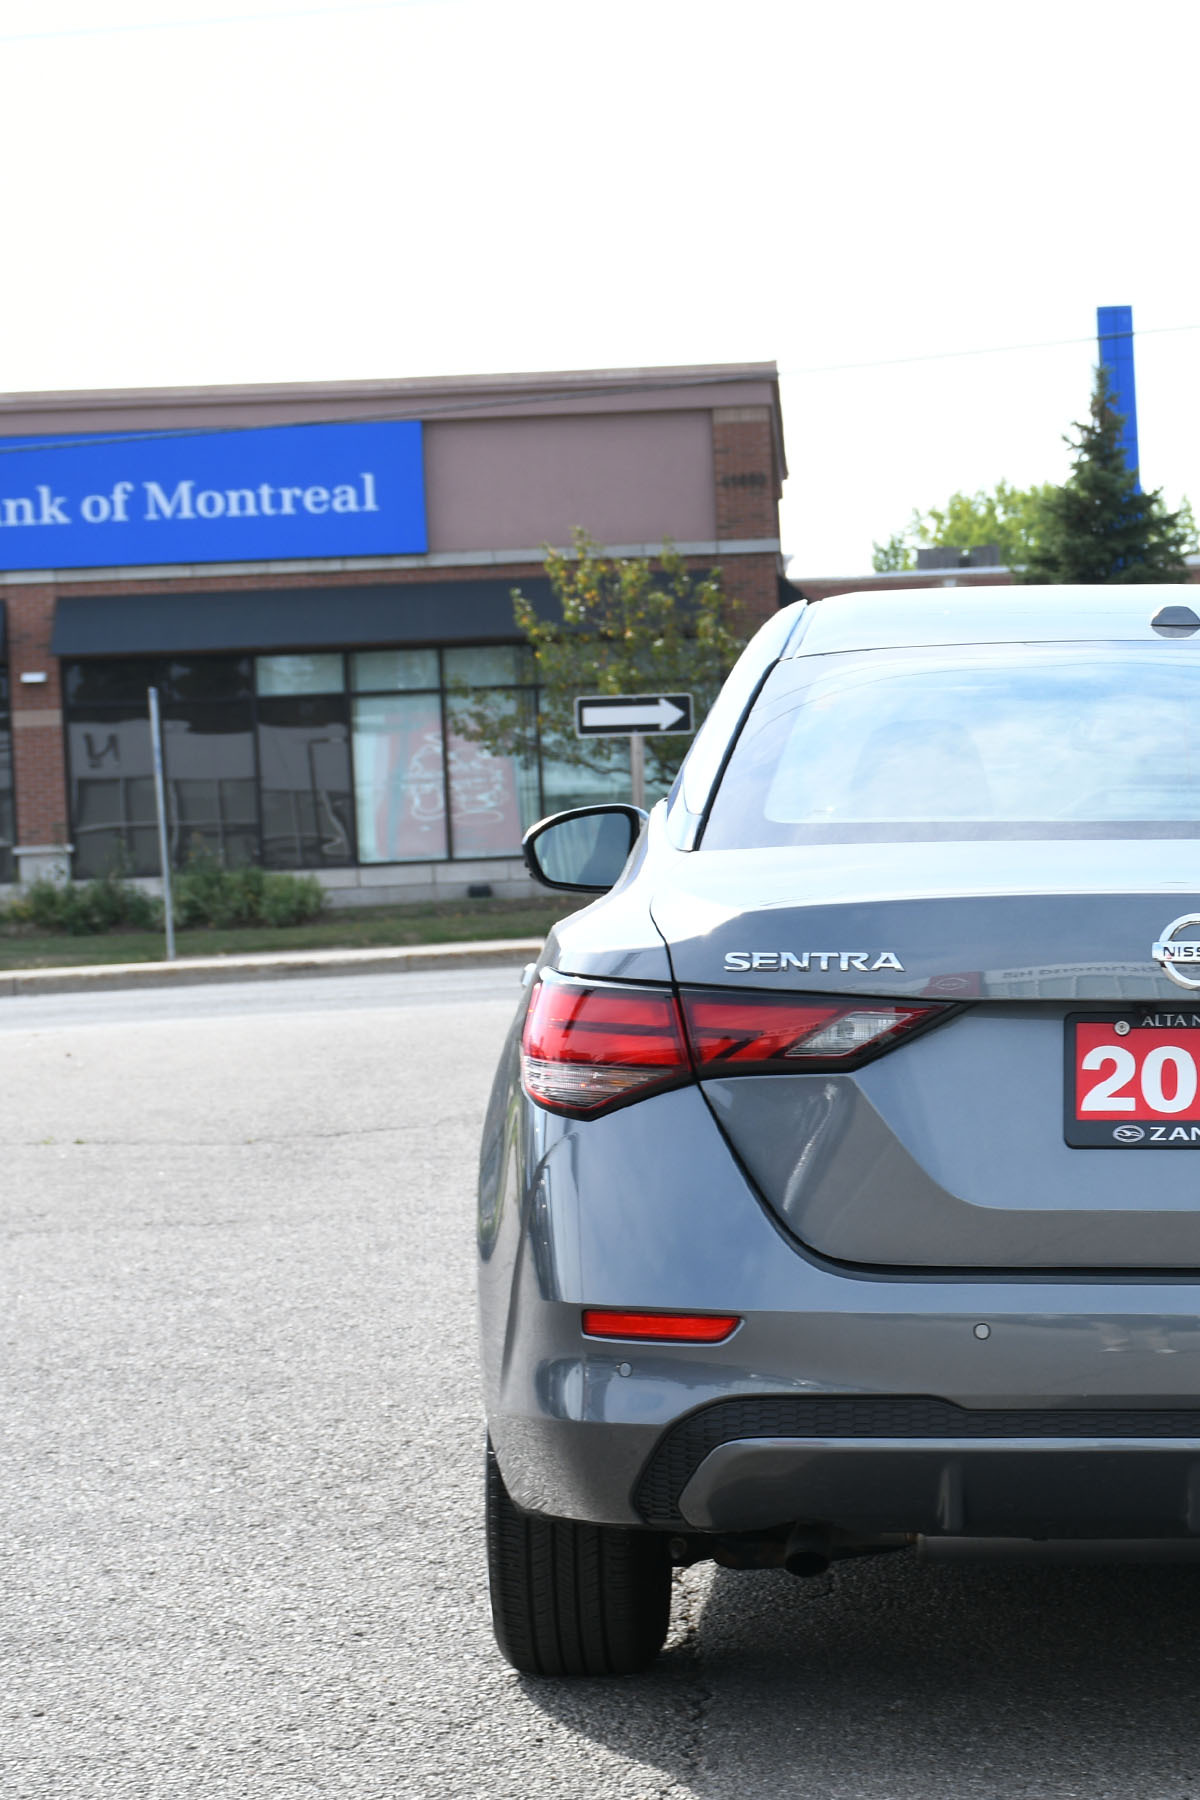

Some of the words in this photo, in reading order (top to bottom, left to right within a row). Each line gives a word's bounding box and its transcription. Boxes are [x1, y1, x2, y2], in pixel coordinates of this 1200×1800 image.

[0, 484, 71, 526] nk
[81, 481, 135, 523] of
[142, 472, 380, 520] Montreal
[724, 951, 906, 972] SENTRA
[1141, 1013, 1187, 1027] ALTA
